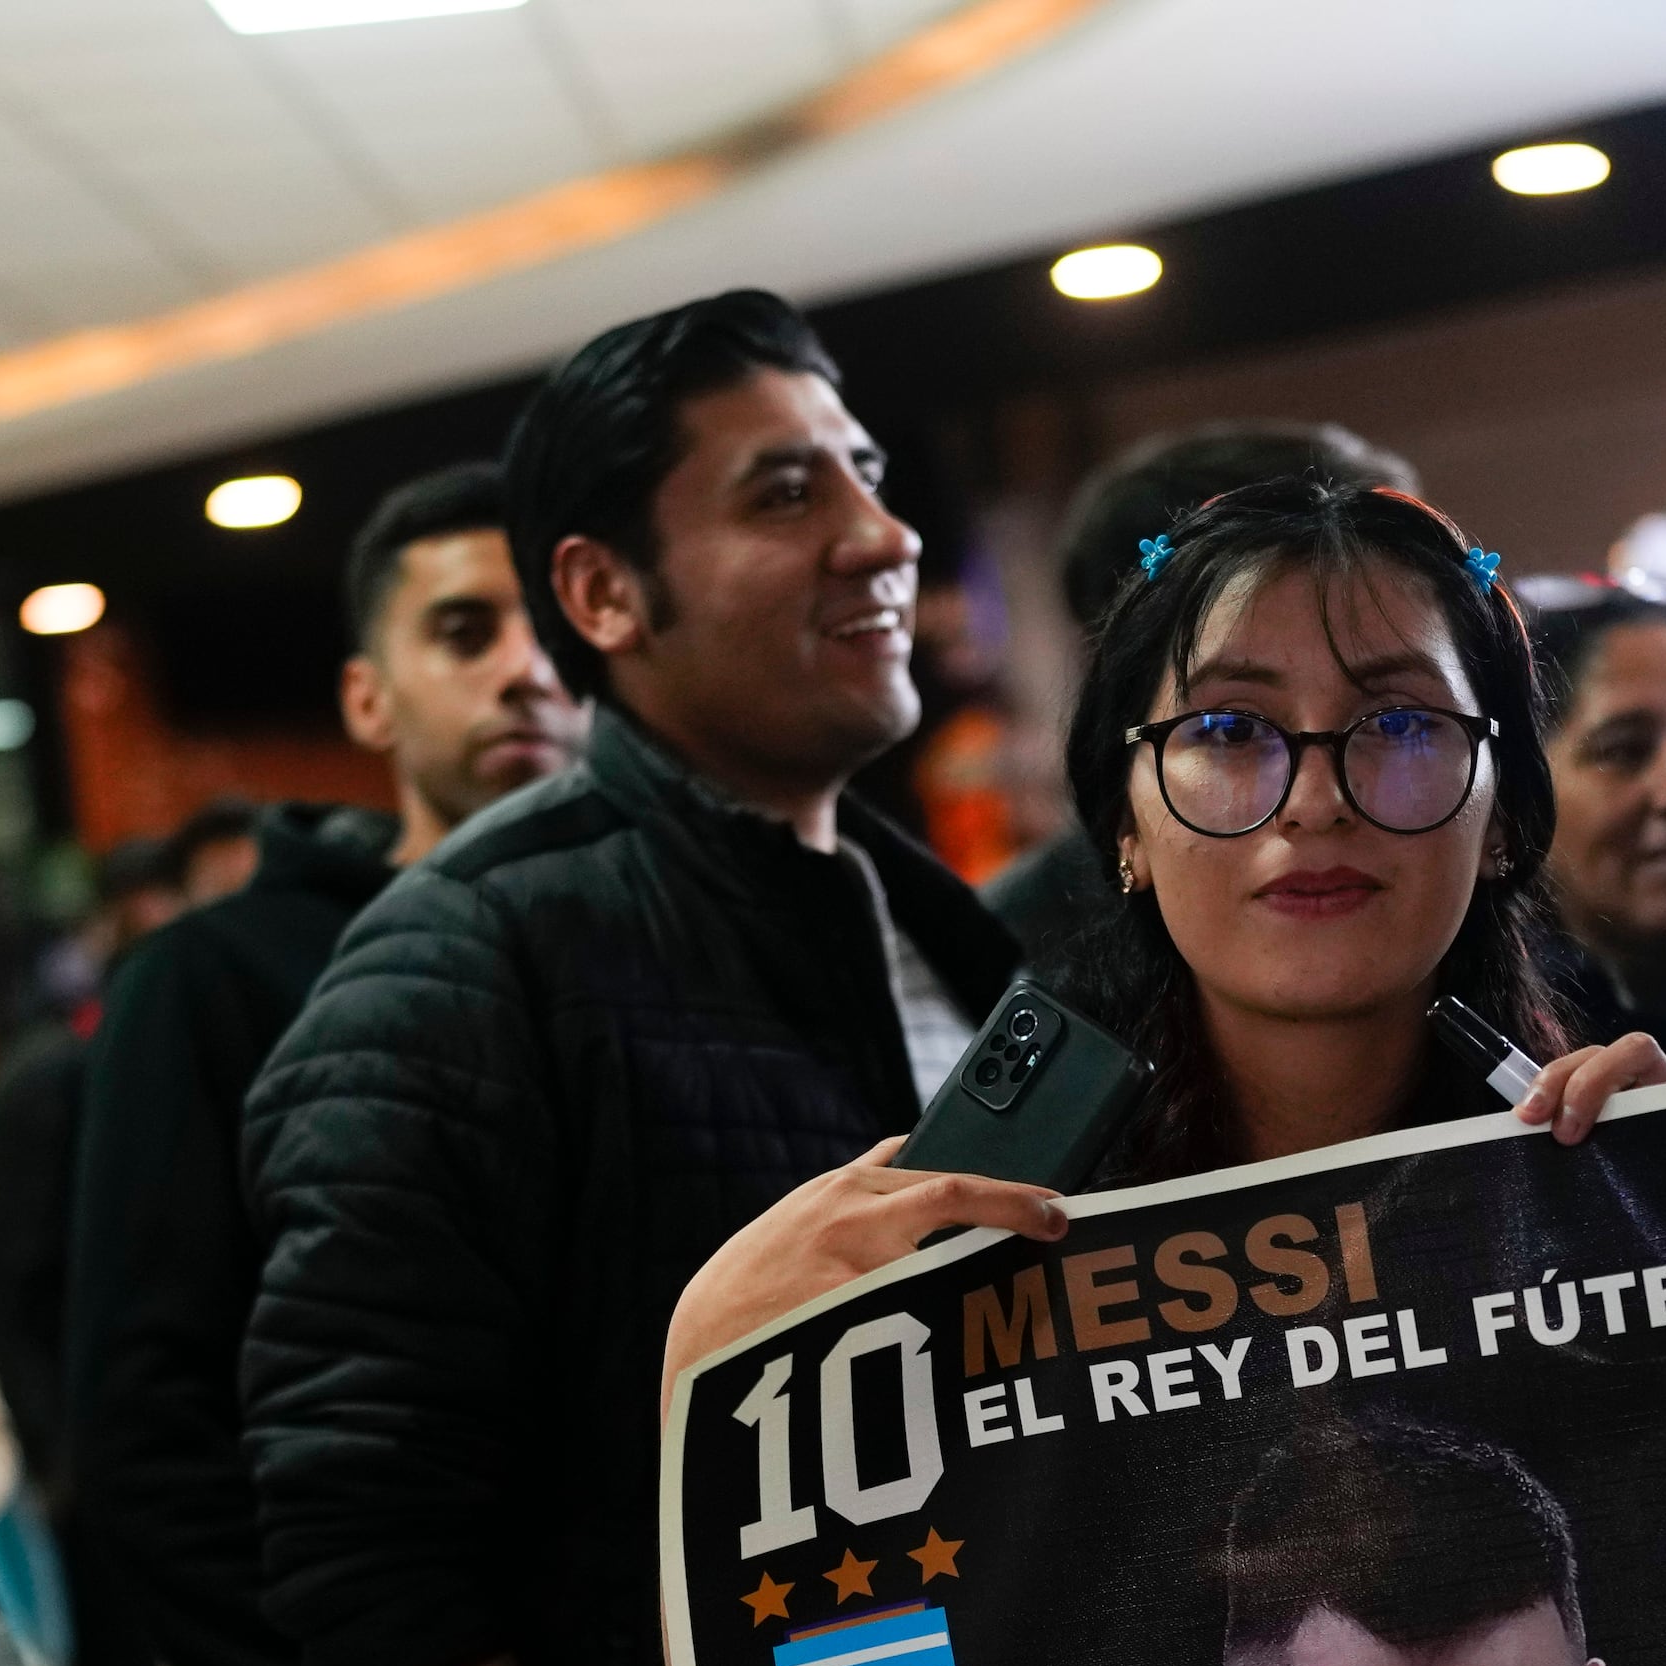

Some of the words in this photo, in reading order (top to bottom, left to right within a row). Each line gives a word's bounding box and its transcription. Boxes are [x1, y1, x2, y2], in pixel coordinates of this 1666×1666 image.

[963, 1202, 1378, 1378] MESSI
[963, 1377, 1065, 1448] EL
[1088, 1337, 1253, 1423] REY
[1285, 1308, 1448, 1388] DEL
[731, 1311, 944, 1560] 10
